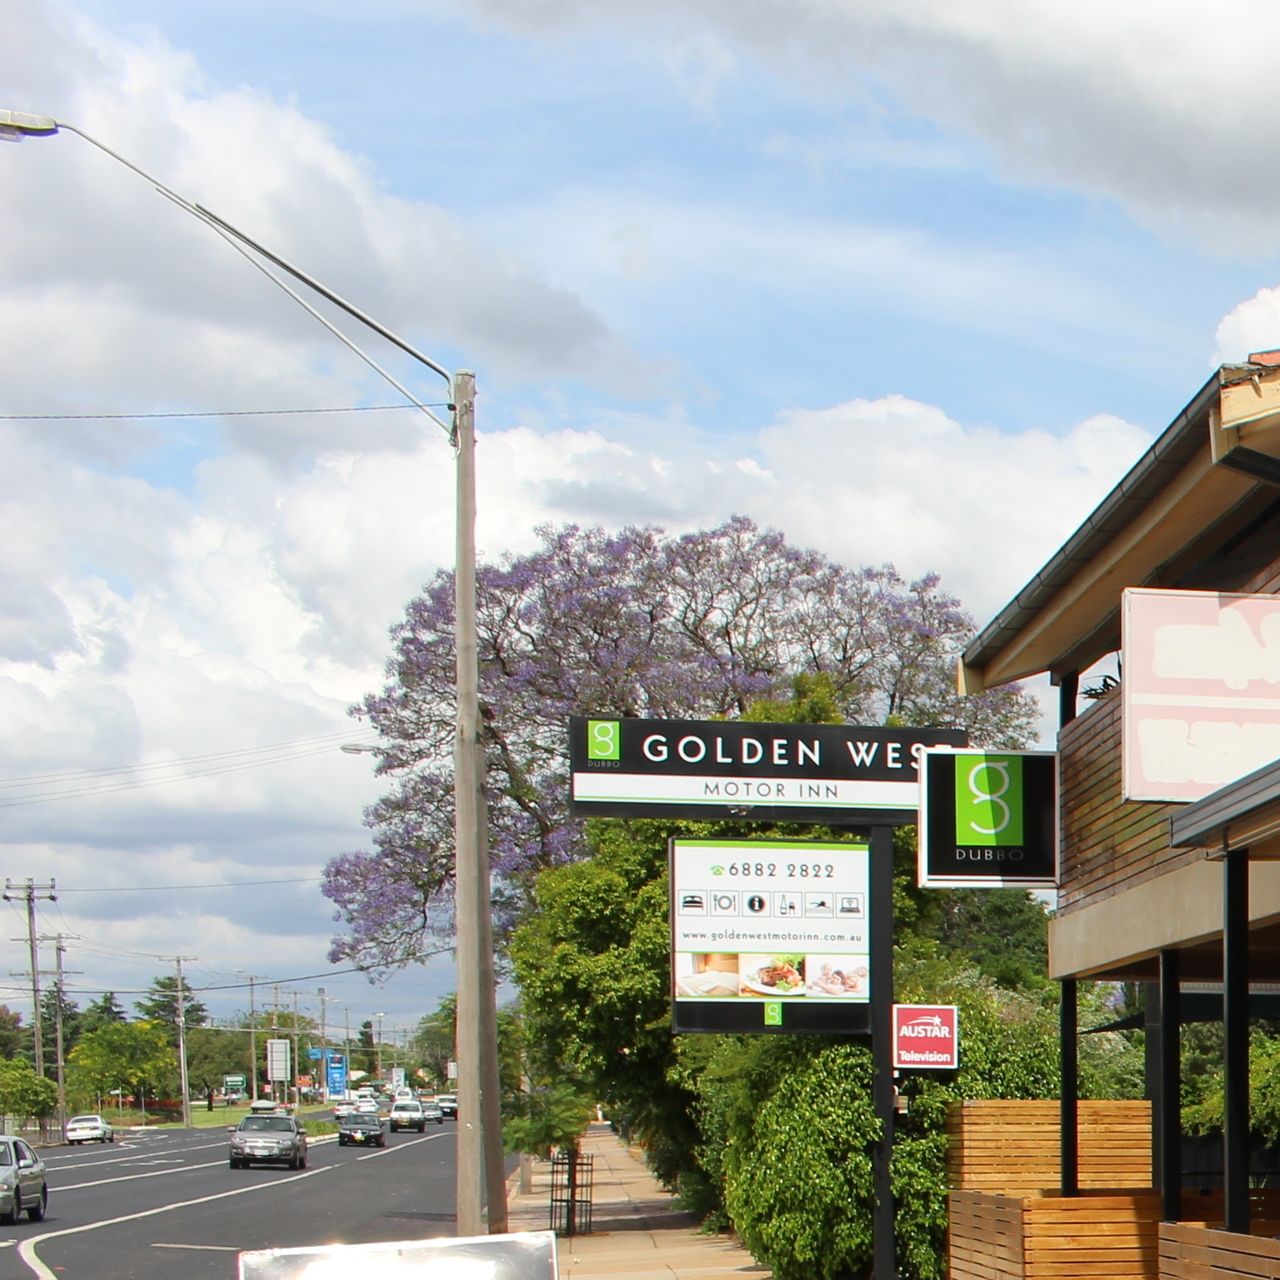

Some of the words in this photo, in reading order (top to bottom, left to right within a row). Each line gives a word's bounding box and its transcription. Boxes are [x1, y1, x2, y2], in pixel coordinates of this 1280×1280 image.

[642, 734, 821, 767] GOLDEN
[846, 740, 952, 770] WES
[704, 781, 786, 798] MOTOR
[799, 783, 839, 799] INN
[955, 848, 1025, 862] DUBBO
[728, 862, 777, 878] 6882
[786, 863, 835, 879] 2822
[682, 929, 863, 942] www.goldenwestmotorinn.com.au
[899, 1025, 951, 1039] AUSTAR
[898, 1050, 951, 1063] Television
